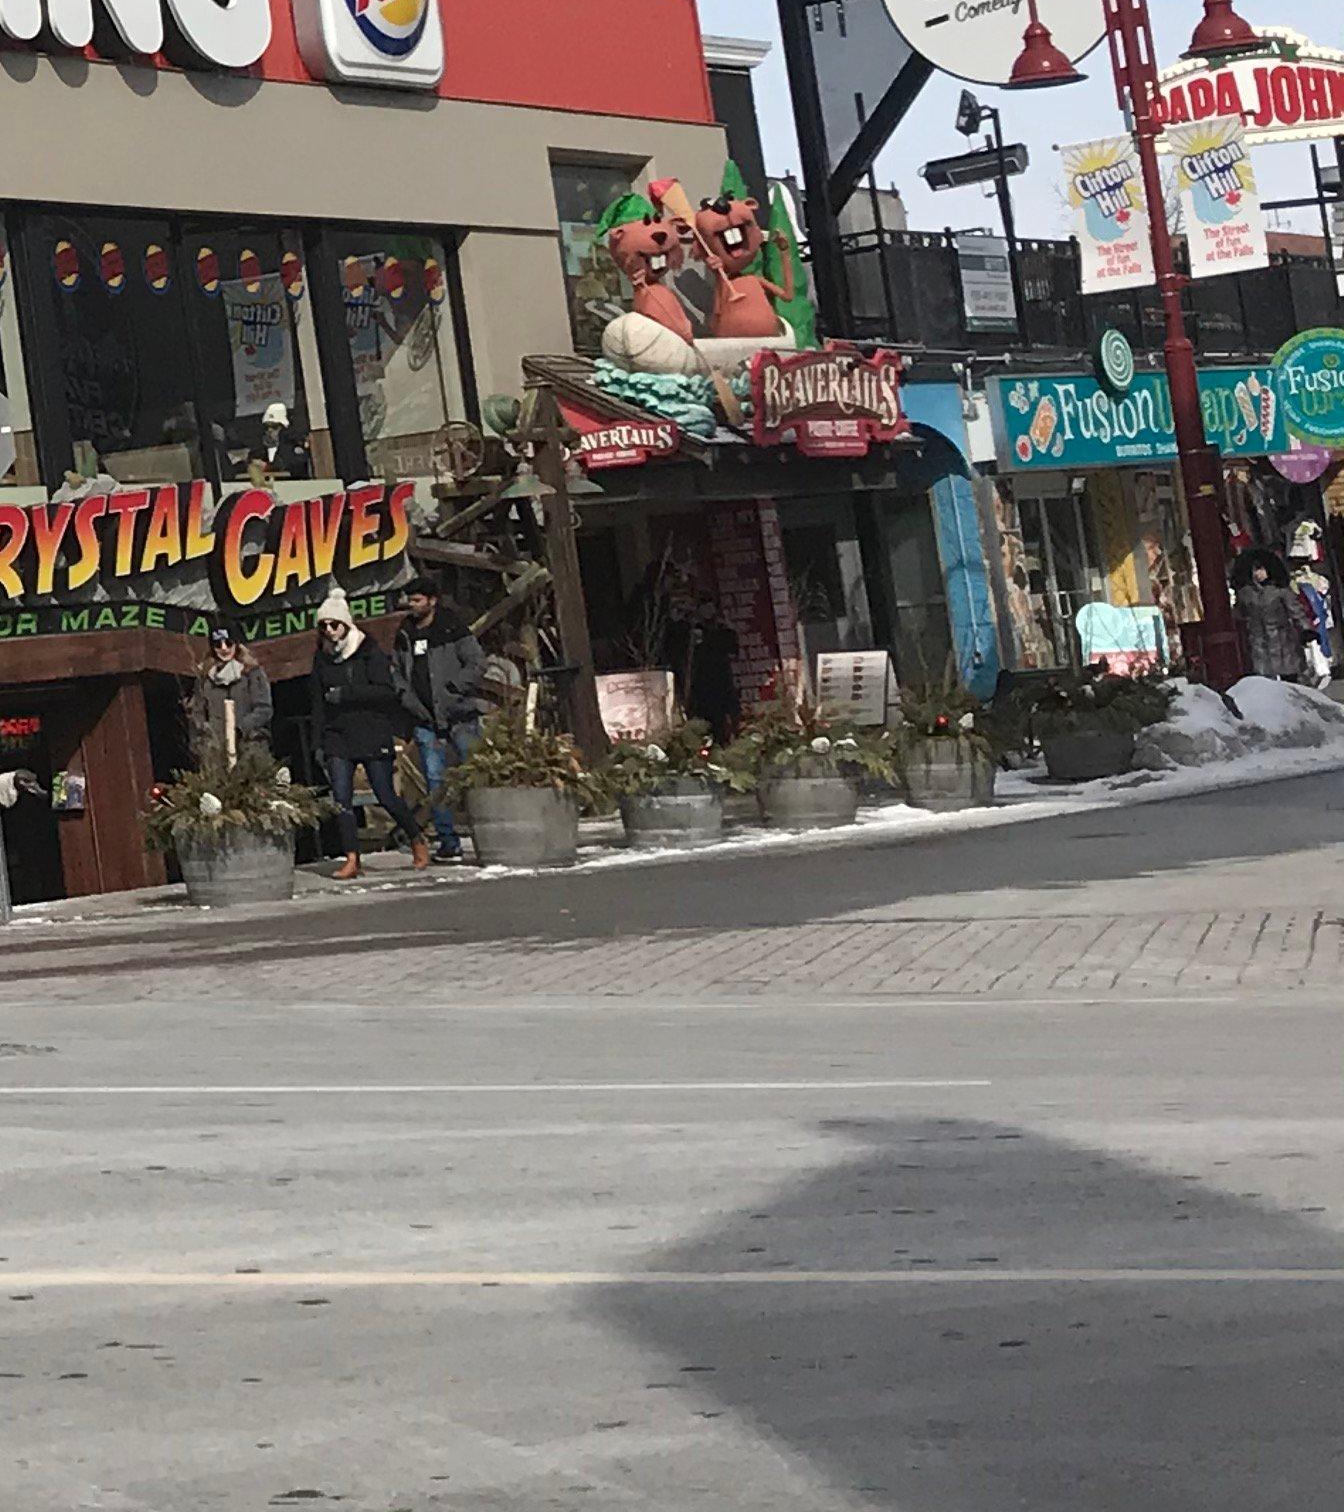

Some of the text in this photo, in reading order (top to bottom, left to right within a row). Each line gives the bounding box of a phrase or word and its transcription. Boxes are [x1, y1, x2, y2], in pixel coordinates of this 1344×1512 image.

[1074, 160, 1133, 199] Clifton
[1180, 141, 1244, 182] Clifton
[1096, 184, 1132, 217] Hill
[1204, 167, 1243, 201] Hill
[1053, 382, 1159, 444] Fusion
[1153, 377, 1240, 455] Wap
[223, 481, 416, 605] CAVES
[61, 602, 167, 632] MAZE
[188, 594, 387, 641] AVENTRE
